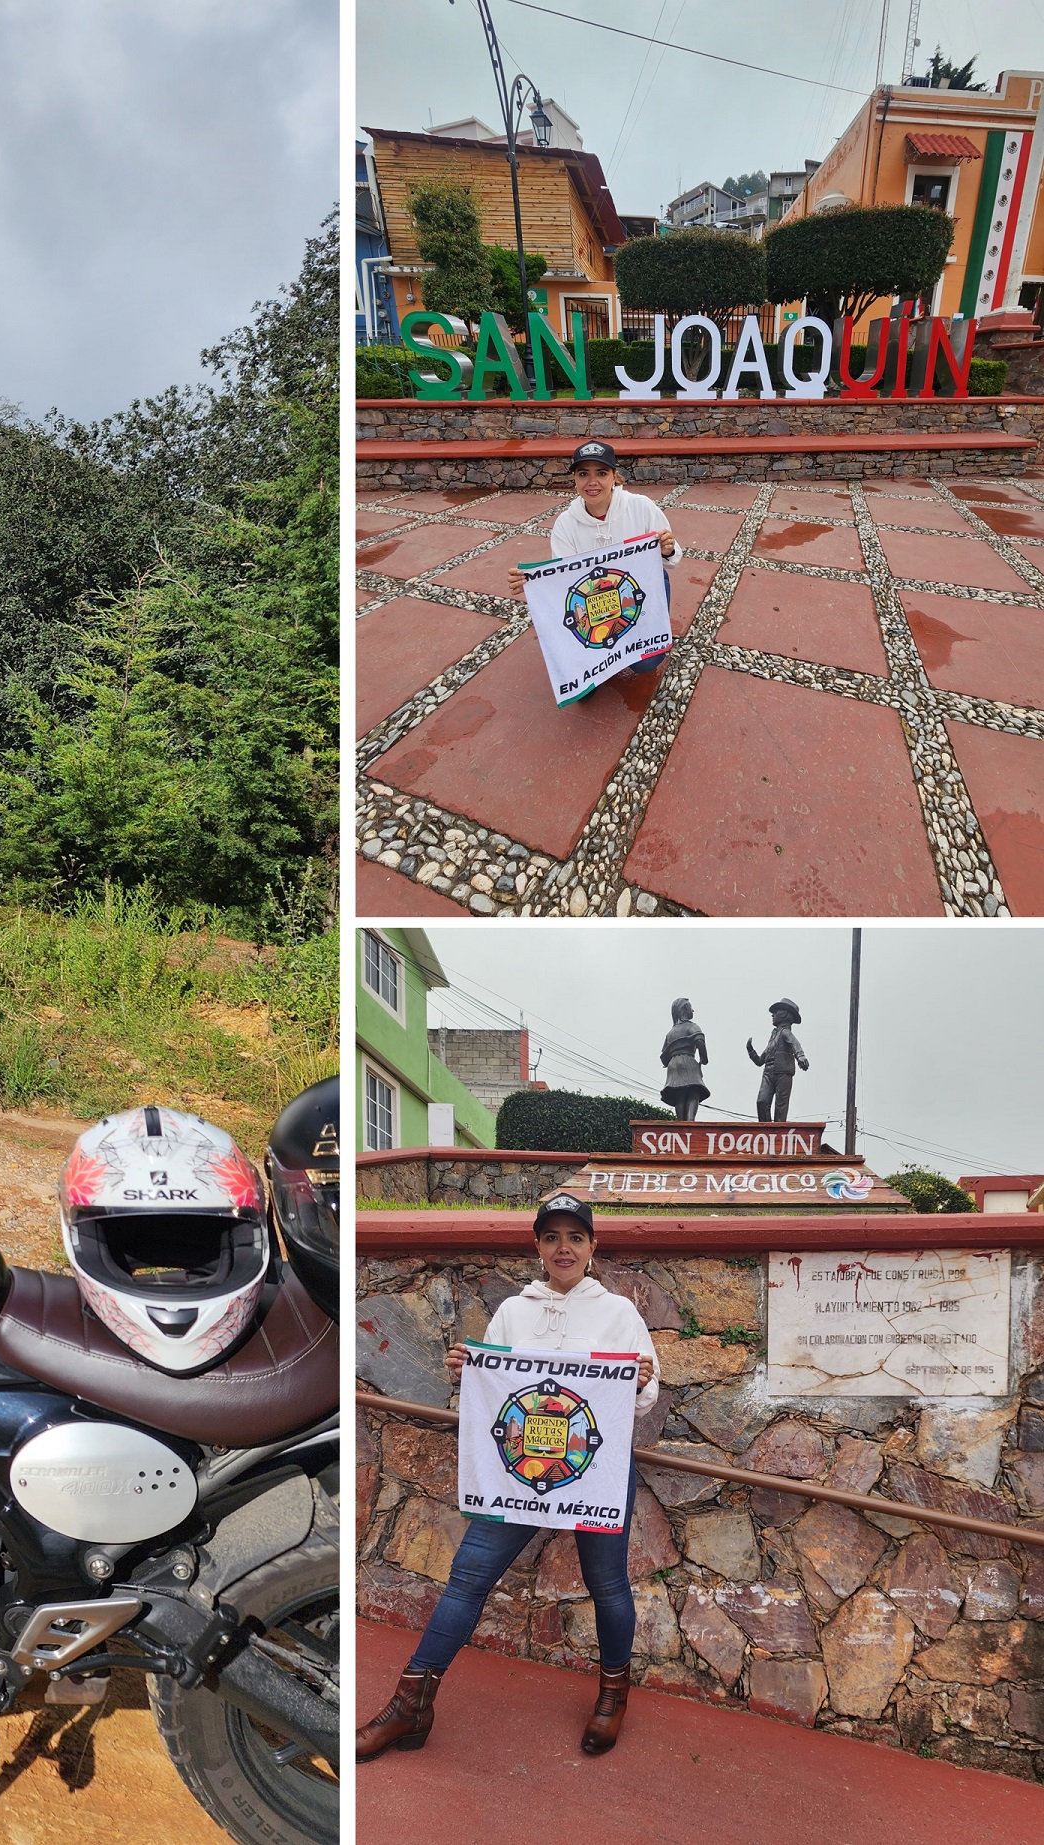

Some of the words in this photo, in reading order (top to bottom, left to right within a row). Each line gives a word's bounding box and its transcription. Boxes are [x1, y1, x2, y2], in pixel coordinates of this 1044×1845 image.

[401, 311, 594, 400] SAN
[559, 679, 578, 695] EN
[583, 653, 621, 682] ACCIÓN
[625, 633, 669, 653] MÉXICO
[123, 1190, 199, 1200] SHARK
[812, 1271, 836, 1280] ESTA
[543, 1384, 555, 1392] N
[20, 1466, 108, 1478] SCRAMBLER
[465, 1495, 484, 1507] EN
[490, 1495, 550, 1513] ACCIÓN
[557, 1500, 621, 1519] MÉXICO
